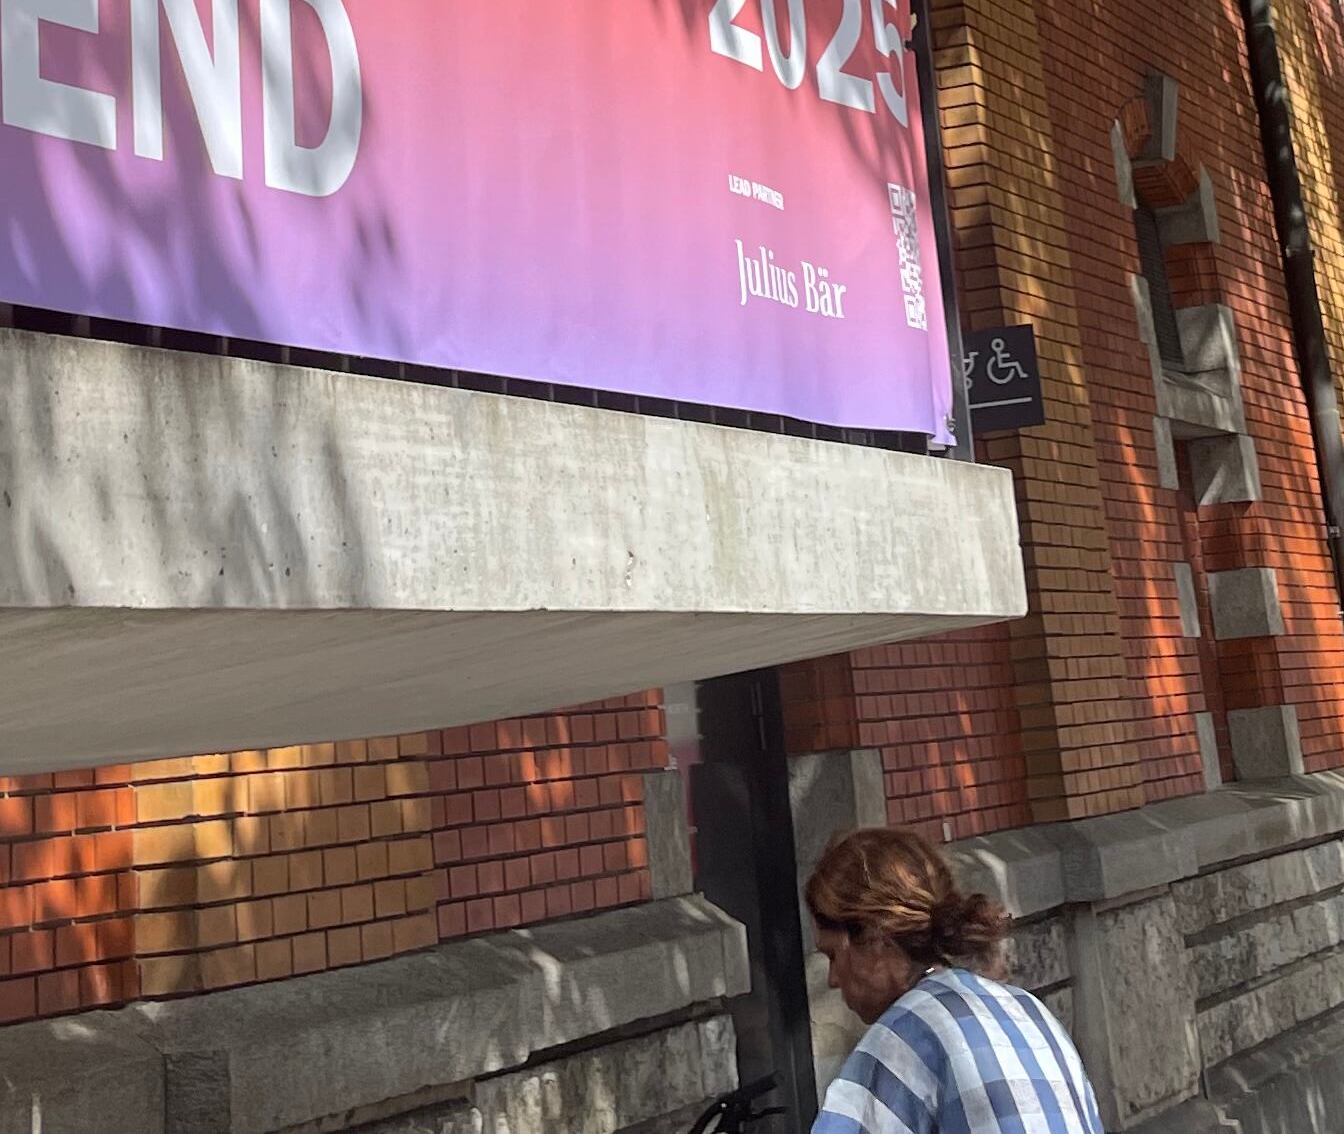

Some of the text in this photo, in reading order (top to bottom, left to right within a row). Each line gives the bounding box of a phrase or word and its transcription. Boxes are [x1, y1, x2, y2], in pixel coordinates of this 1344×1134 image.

[728, 174, 785, 211] LEAD PARTNER
[734, 238, 847, 319] Julius Bär
